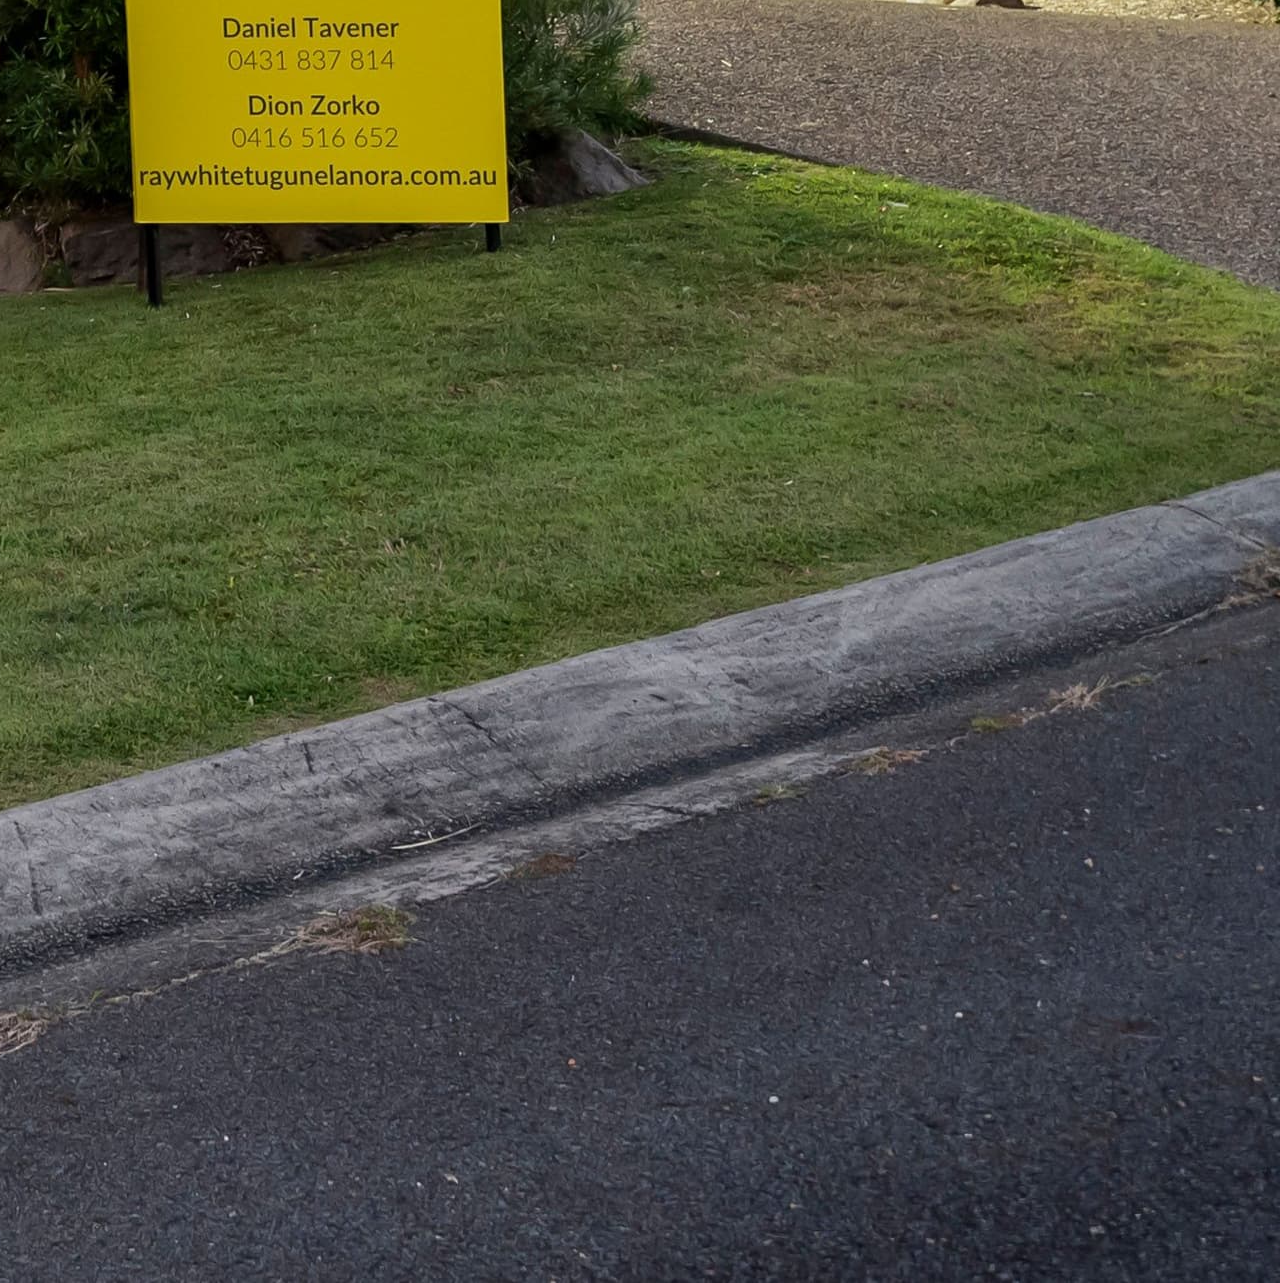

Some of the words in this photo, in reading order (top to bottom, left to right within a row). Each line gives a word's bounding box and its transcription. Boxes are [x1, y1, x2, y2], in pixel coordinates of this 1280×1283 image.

[223, 17, 295, 38] Daniel
[303, 18, 399, 38] Tavener
[228, 50, 287, 70] 0431
[298, 50, 341, 70] 837
[351, 50, 394, 70] 814
[249, 95, 303, 115] Dion
[311, 94, 380, 115] Zorko
[232, 128, 292, 148] 0416
[302, 128, 345, 148] 516
[355, 127, 398, 148] 652
[140, 164, 496, 190] raywhitetugunelanora.com.au
